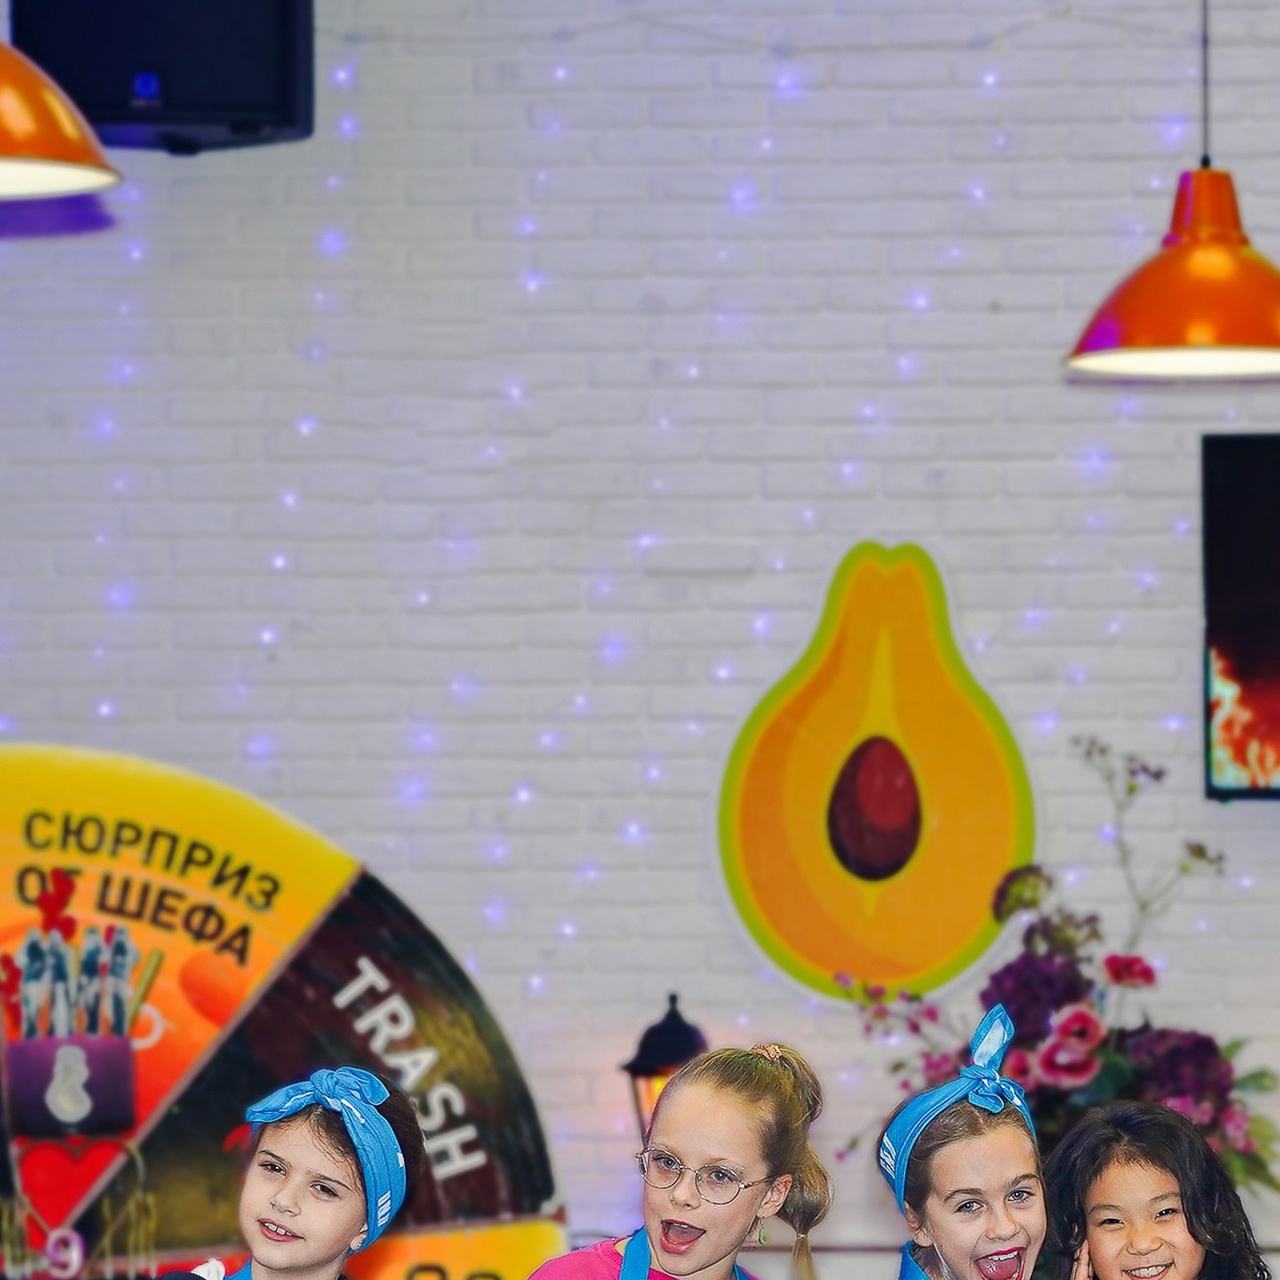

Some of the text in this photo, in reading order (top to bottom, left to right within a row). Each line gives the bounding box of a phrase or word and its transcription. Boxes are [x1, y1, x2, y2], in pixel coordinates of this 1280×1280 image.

[23, 811, 281, 913] СЮРПРИЗ
[97, 875, 254, 966] ШЕФА
[332, 957, 487, 1181] TRASH
